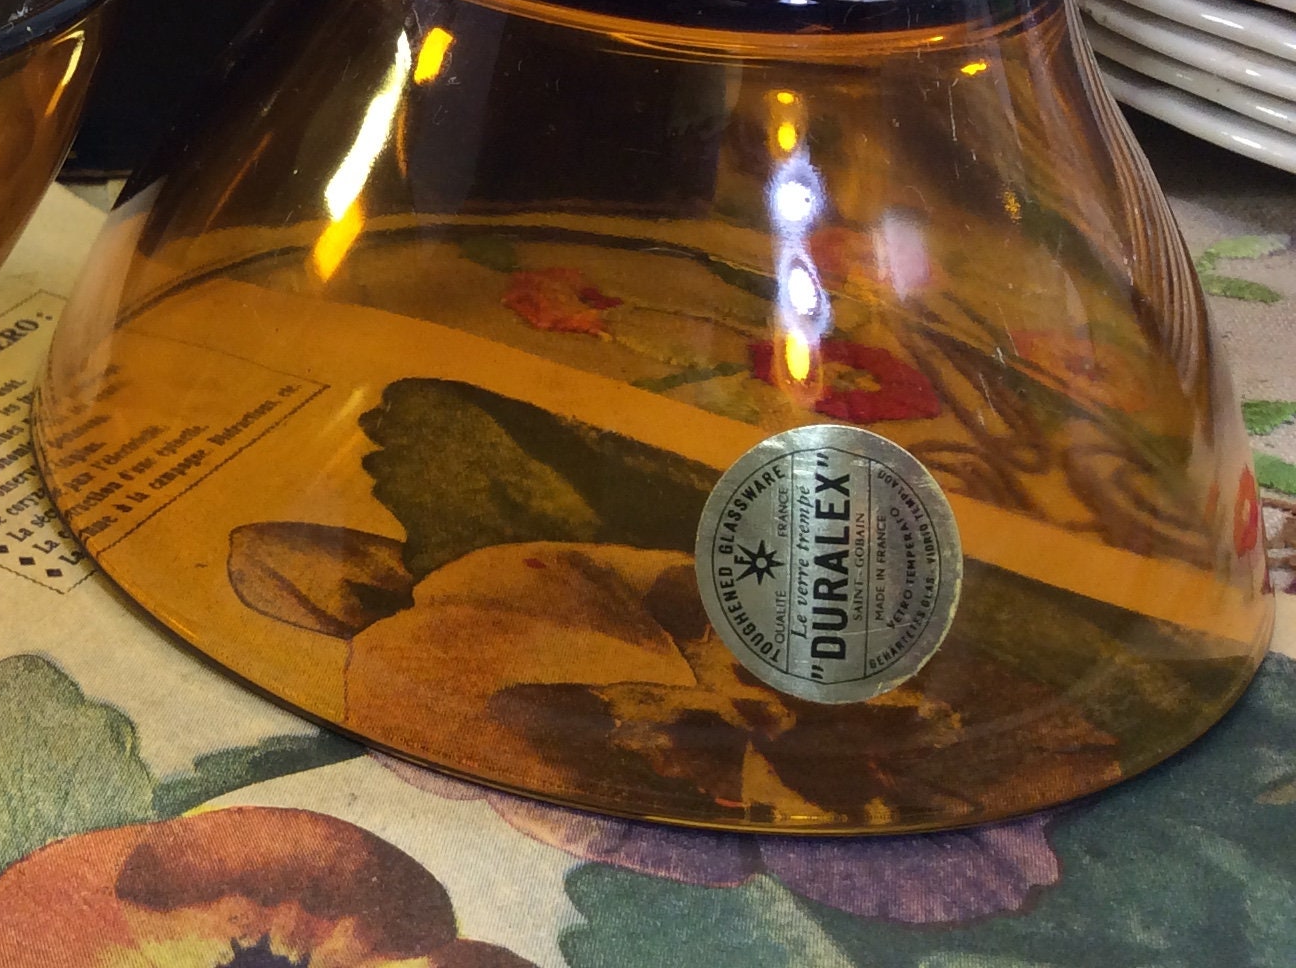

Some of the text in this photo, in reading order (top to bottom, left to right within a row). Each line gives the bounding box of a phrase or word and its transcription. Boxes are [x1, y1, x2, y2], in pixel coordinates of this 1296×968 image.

[5, 527, 35, 543] La
[778, 486, 789, 538] FRANCE
[32, 539, 61, 554] La
[718, 464, 786, 662] TOUGHENED GLASSWARE
[792, 485, 813, 639] Le verre trempé
[875, 515, 886, 621] MADE IN FRANCE
[887, 506, 916, 630] VETRO TEMPERATO
[918, 523, 936, 564] VIDRIO
[919, 576, 935, 608] GLAS
